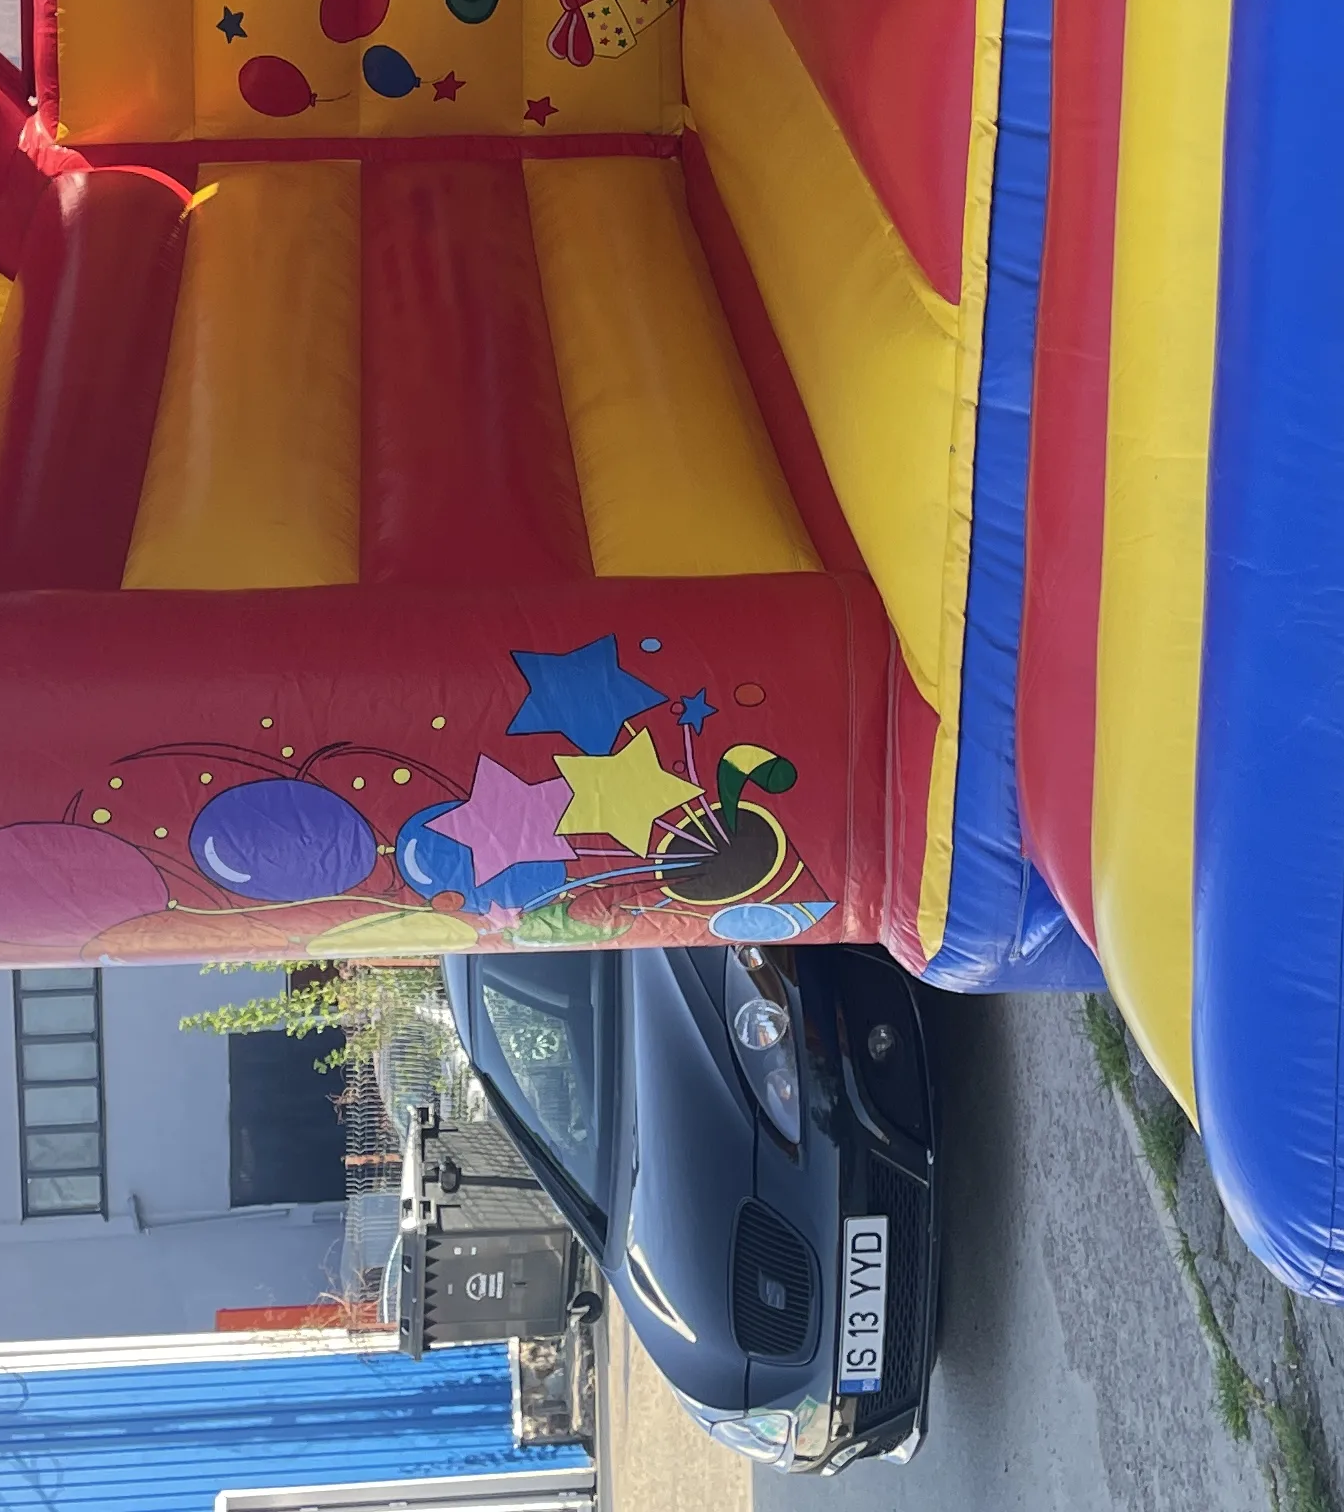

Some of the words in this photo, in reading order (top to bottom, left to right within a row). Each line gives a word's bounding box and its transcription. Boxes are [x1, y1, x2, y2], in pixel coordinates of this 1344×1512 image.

[850, 1232, 882, 1298] YYD
[848, 1312, 879, 1338] 13
[846, 1348, 877, 1373] IS
